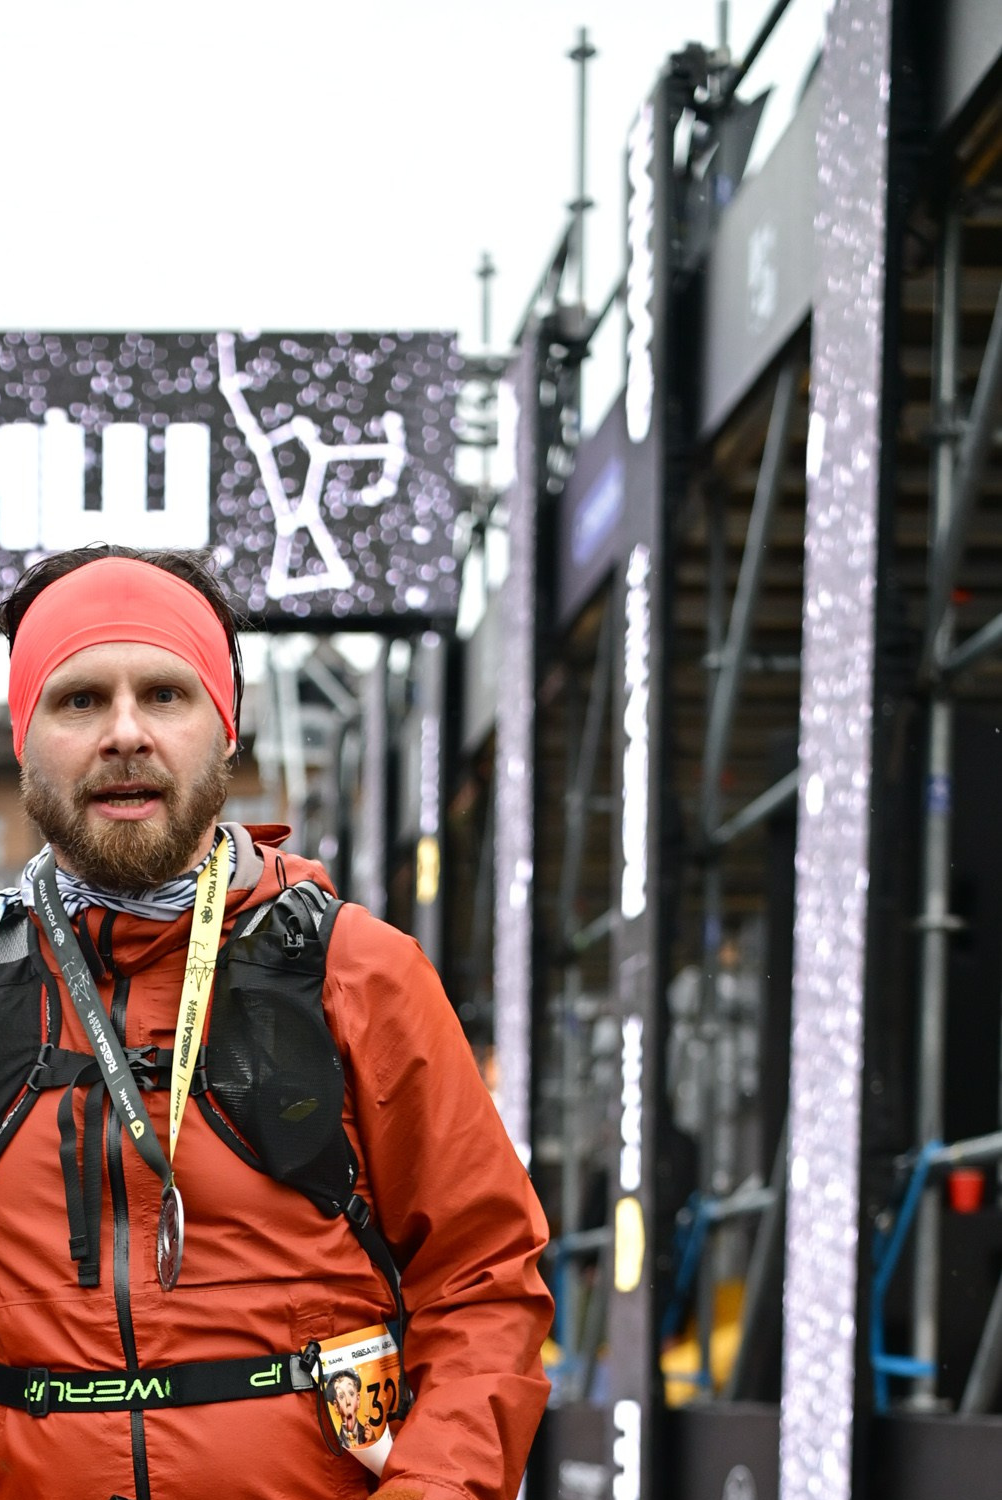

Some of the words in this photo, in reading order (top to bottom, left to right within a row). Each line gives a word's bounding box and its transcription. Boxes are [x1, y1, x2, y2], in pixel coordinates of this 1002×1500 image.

[39, 879, 48, 904] ХУТОР
[207, 881, 217, 904] РОЗА
[44, 903, 57, 927] РОЗА
[97, 1032, 118, 1074] ROSA
[180, 1026, 194, 1068] ROSA
[119, 1088, 136, 1120] БАНК
